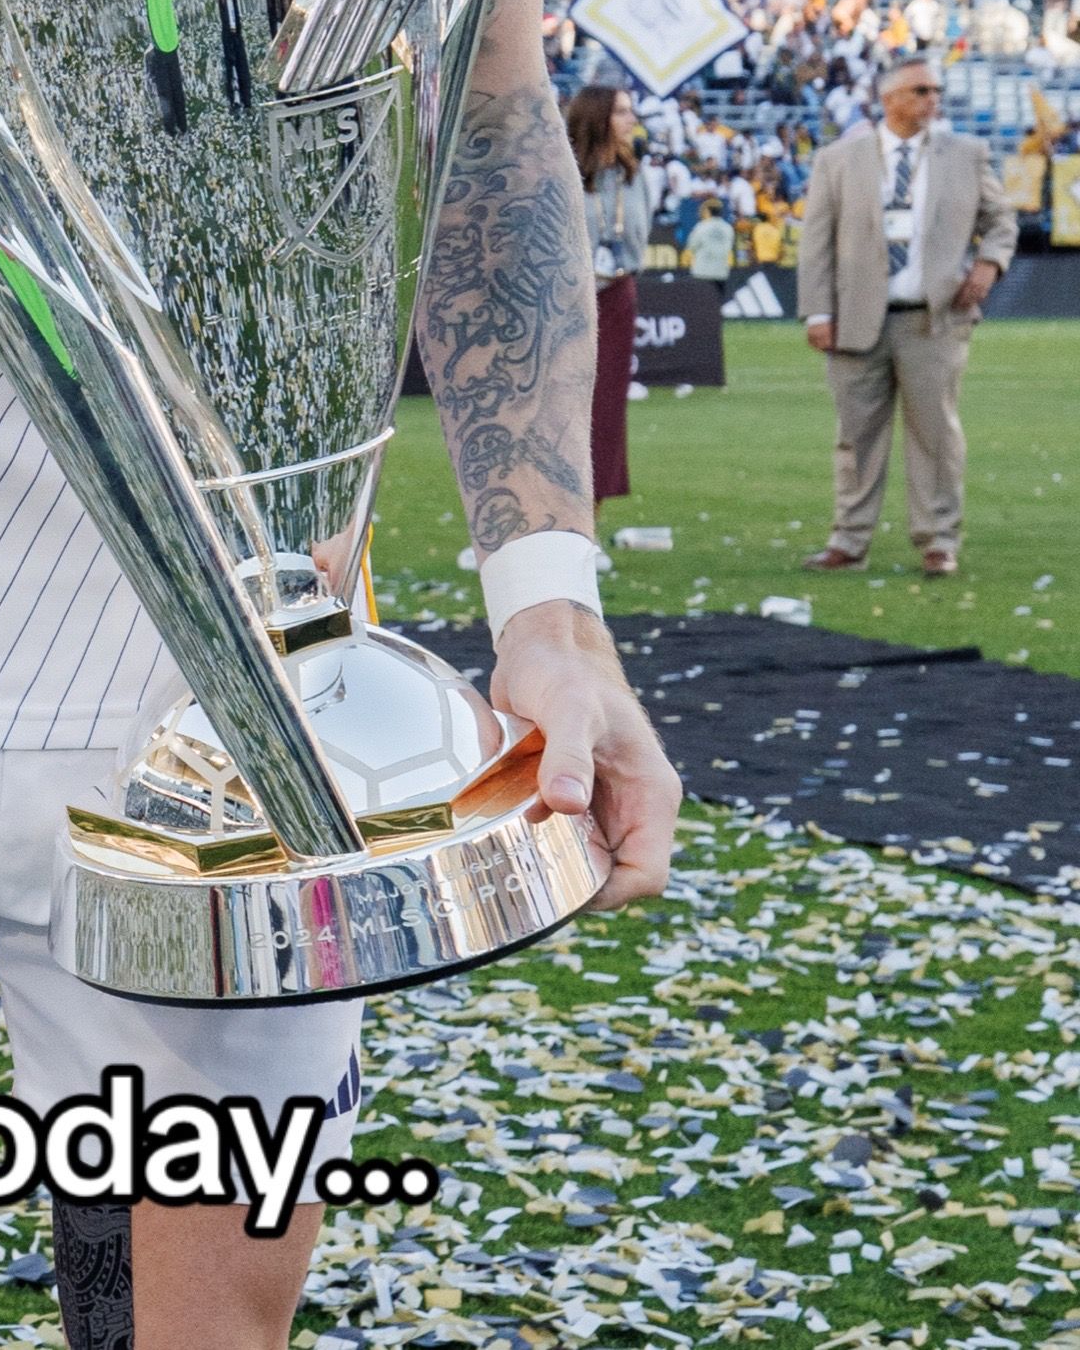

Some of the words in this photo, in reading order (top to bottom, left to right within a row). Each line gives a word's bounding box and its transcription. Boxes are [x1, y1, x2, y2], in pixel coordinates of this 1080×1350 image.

[282, 107, 360, 152] MLS
[356, 880, 428, 905] MAJOR
[250, 925, 336, 951] 2024
[349, 908, 422, 943] MLS
[434, 886, 497, 918] CUP
